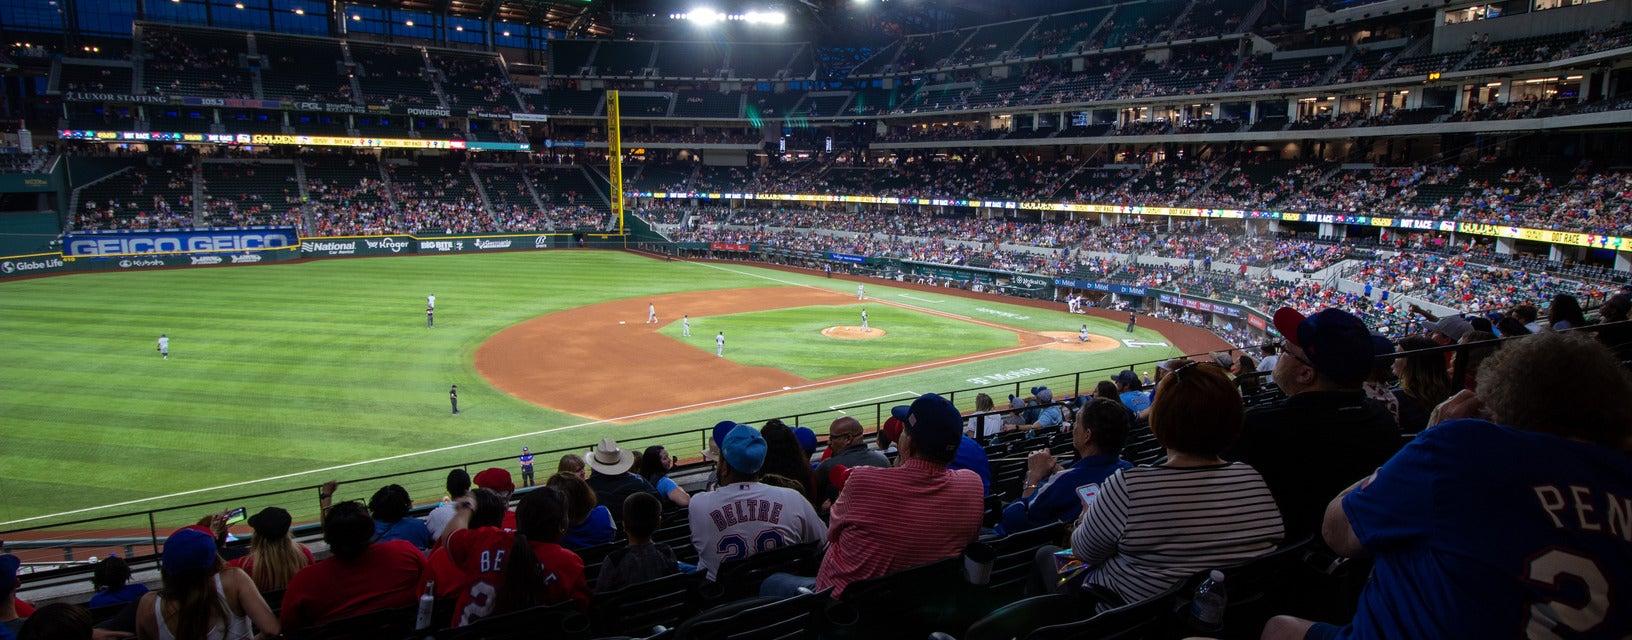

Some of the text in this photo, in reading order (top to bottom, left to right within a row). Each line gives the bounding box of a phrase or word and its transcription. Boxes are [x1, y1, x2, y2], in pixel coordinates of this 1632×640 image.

[78, 93, 166, 103] LUXOR STAFFING
[301, 102, 322, 110] PGL
[407, 108, 451, 117] POWERADE
[252, 134, 295, 145] GOLDEN
[1180, 208, 1192, 216] RACE
[1306, 213, 1317, 222] DOT
[1317, 214, 1334, 223] RACE
[1400, 219, 1414, 228] DOT
[1414, 219, 1433, 230] RACE
[1460, 222, 1499, 235] GOLDEN
[1551, 232, 1563, 242] DOT
[1563, 233, 1580, 245] RACE
[70, 234, 288, 257] GEICO GEICO
[313, 241, 356, 252] National
[380, 237, 409, 253] Kroger
[435, 241, 454, 249] BITE
[16, 258, 63, 271] Globe Life
[1061, 279, 1076, 287] Mitel
[1094, 283, 1109, 291] Mitel
[1128, 287, 1145, 295] Mitel
[709, 498, 784, 533] BELTRE
[1532, 483, 1632, 544] PEN
[1522, 546, 1613, 640] 2
